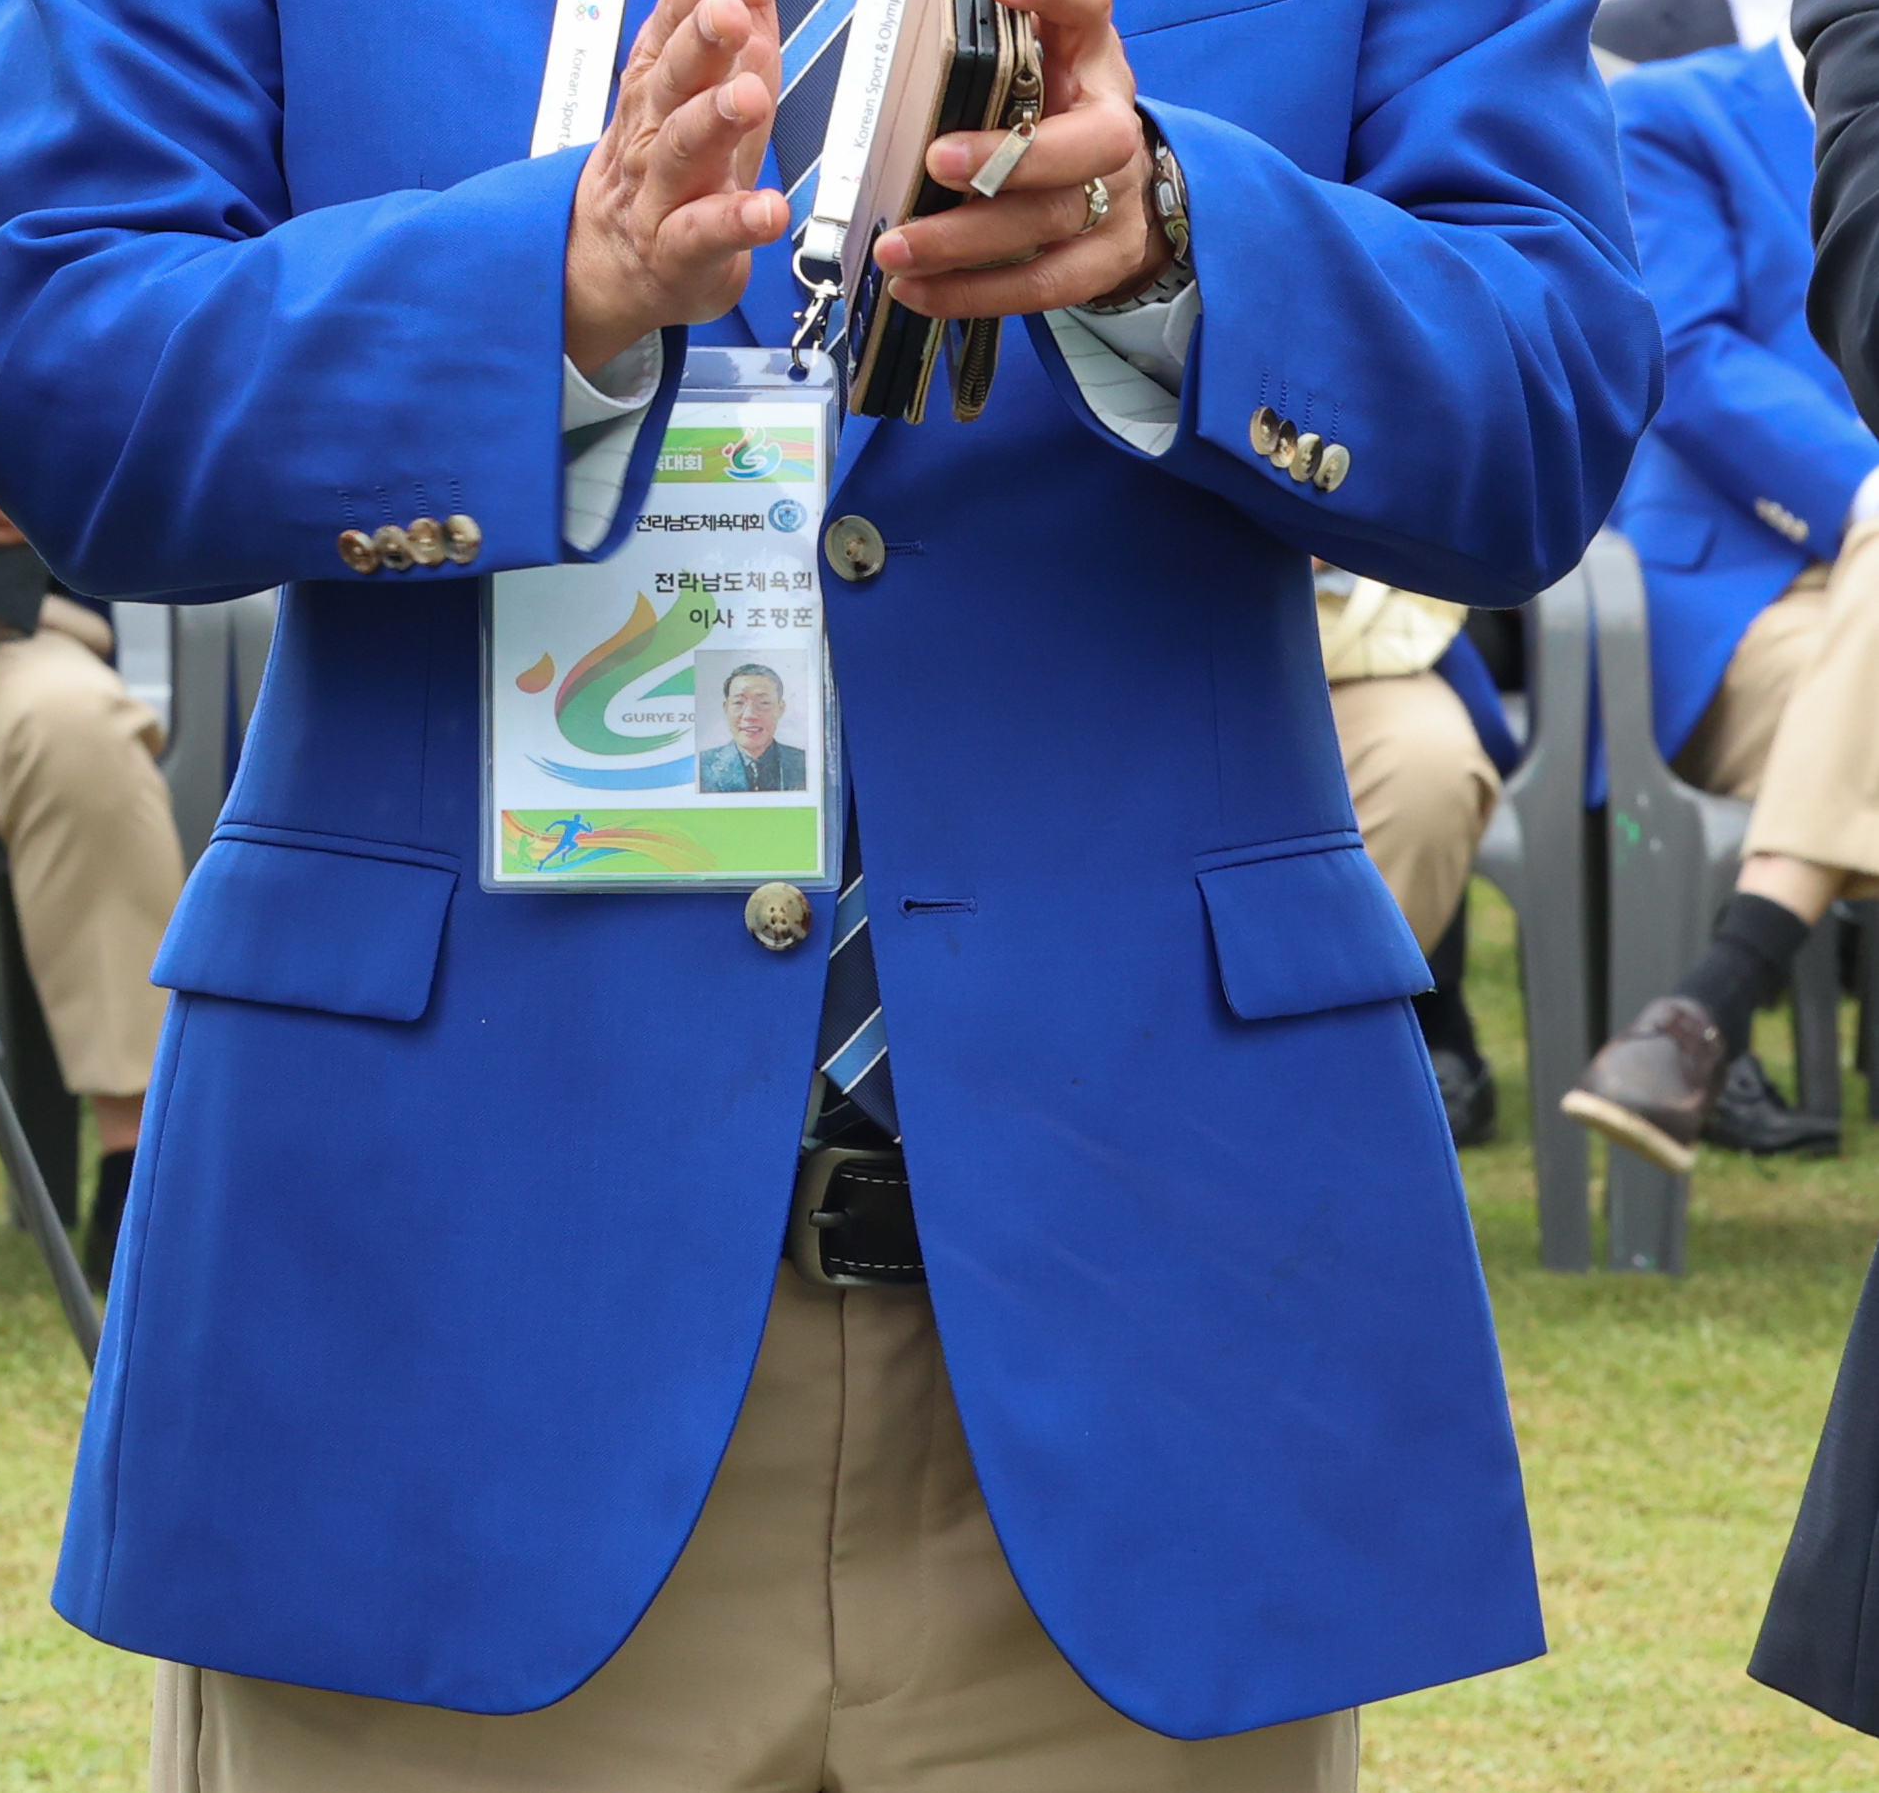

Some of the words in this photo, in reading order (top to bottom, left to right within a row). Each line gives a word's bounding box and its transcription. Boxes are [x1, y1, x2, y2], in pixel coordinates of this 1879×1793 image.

[875, 39, 888, 53] &
[567, 48, 586, 97] Korean
[866, 51, 886, 98] Sport
[559, 102, 578, 144] Sport
[853, 96, 878, 150] Korean
[635, 513, 764, 532] 전라남도체육대회
[655, 571, 812, 593] 전라남도체육회
[689, 608, 734, 629] 이사
[747, 607, 813, 629] 조평훈
[622, 712, 675, 723] GURYE
